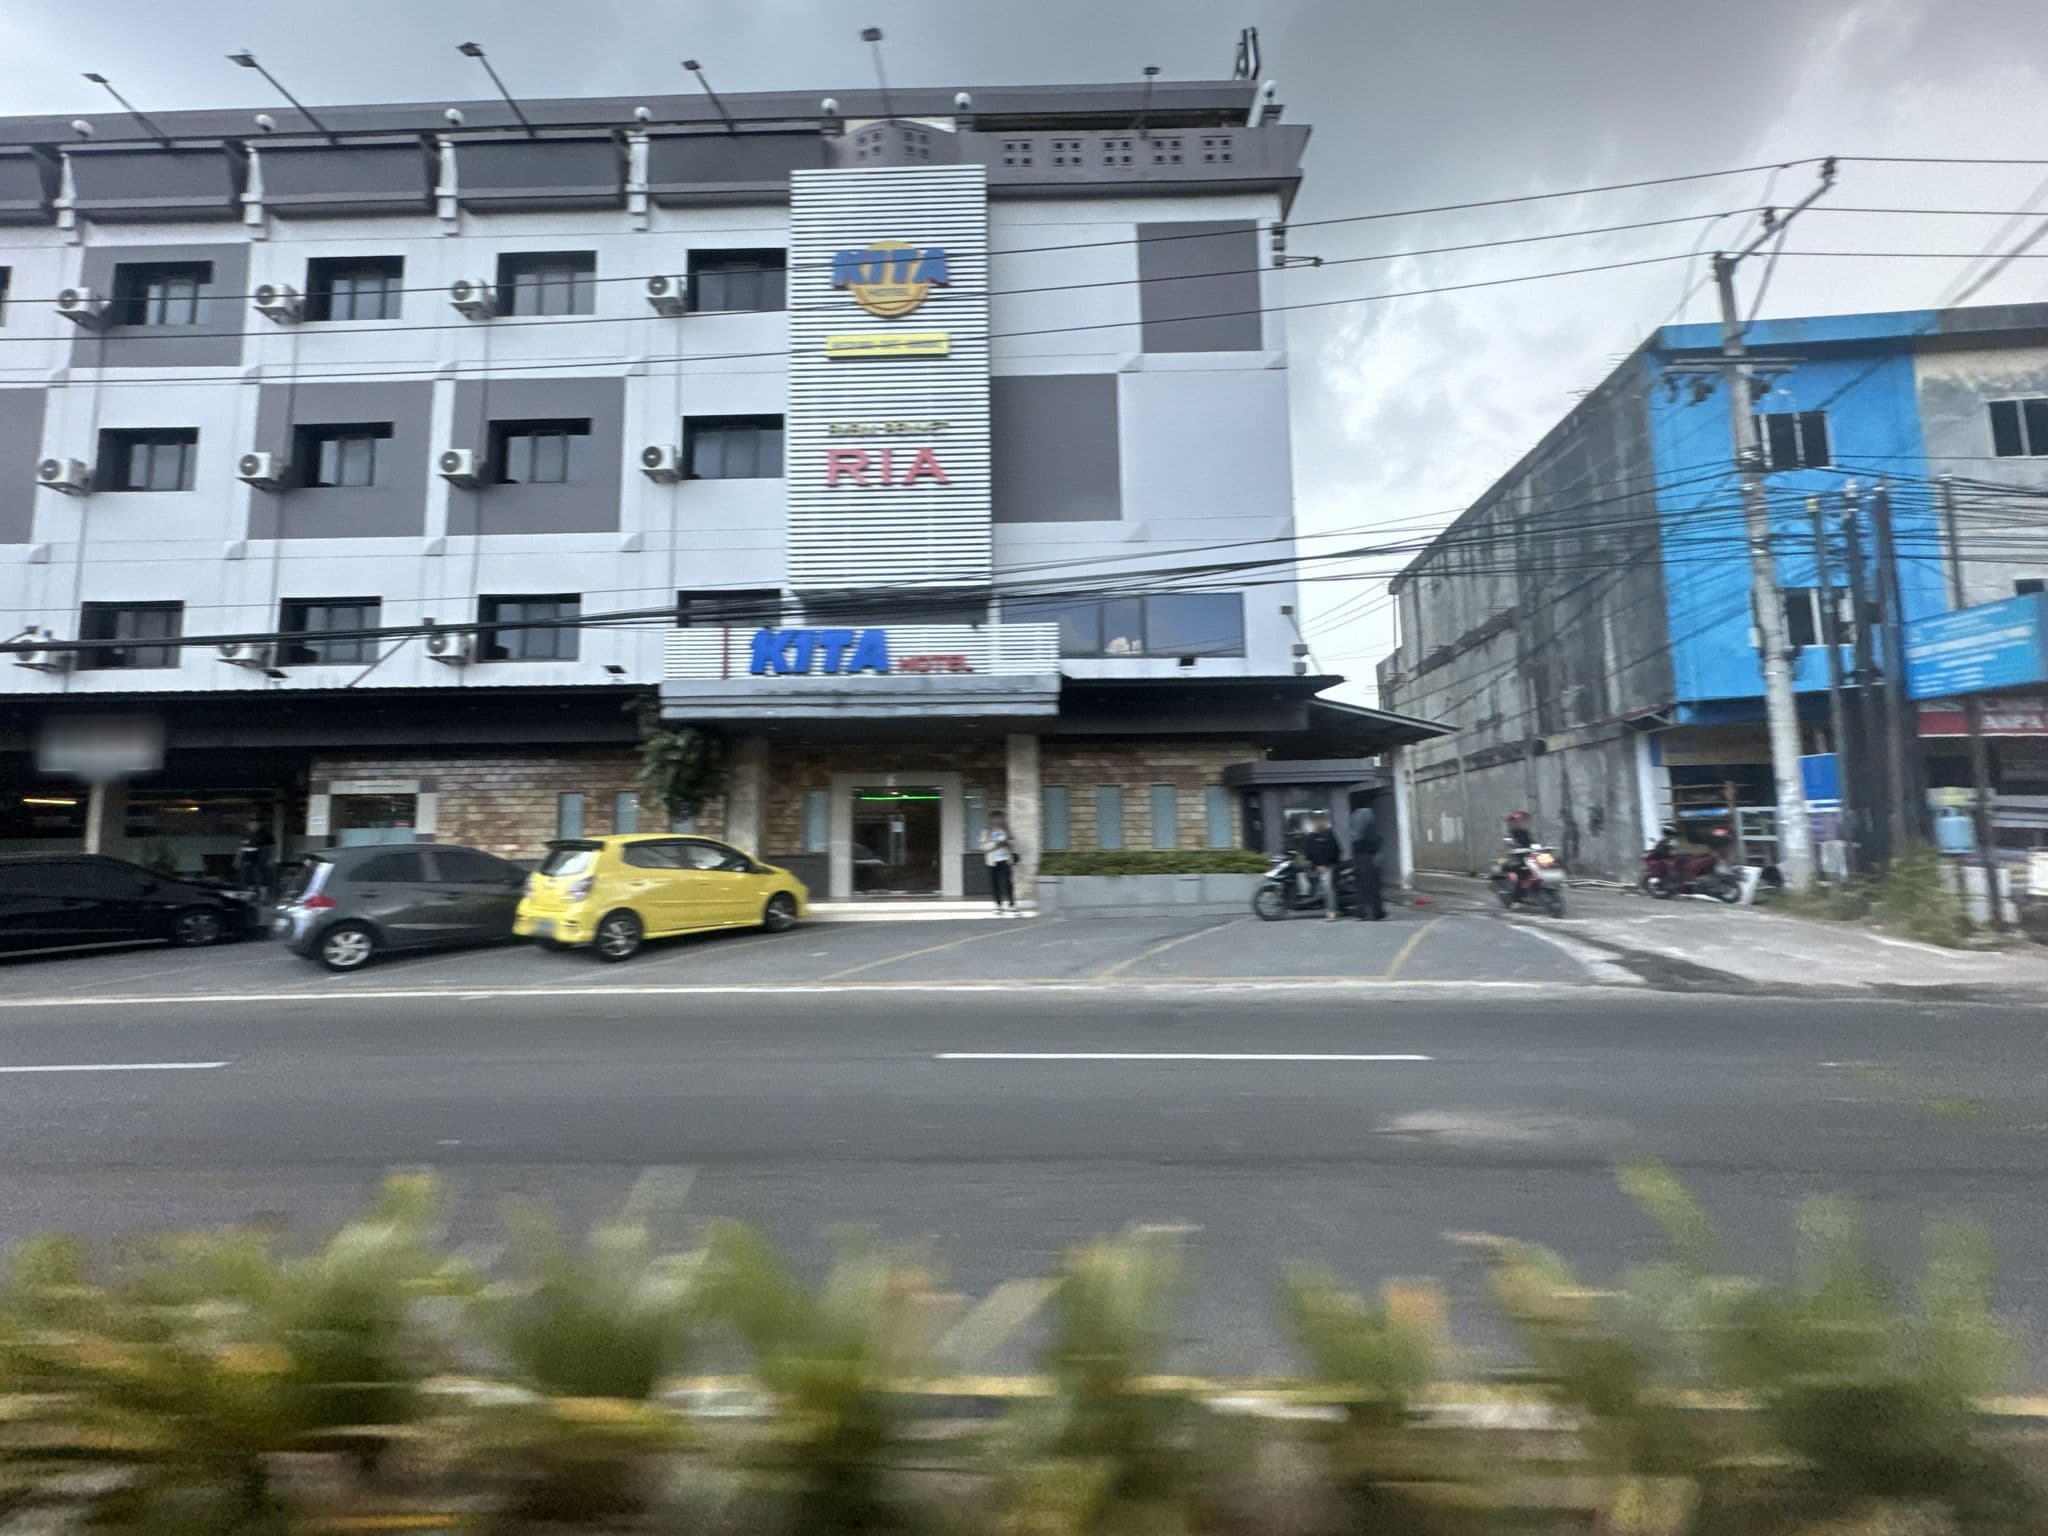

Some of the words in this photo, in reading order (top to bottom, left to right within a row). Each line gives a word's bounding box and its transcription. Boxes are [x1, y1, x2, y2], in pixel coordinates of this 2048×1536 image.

[832, 247, 948, 286] KITA
[827, 447, 950, 485] RIA
[751, 629, 889, 675] KITA
[898, 655, 973, 673] HOTEL
